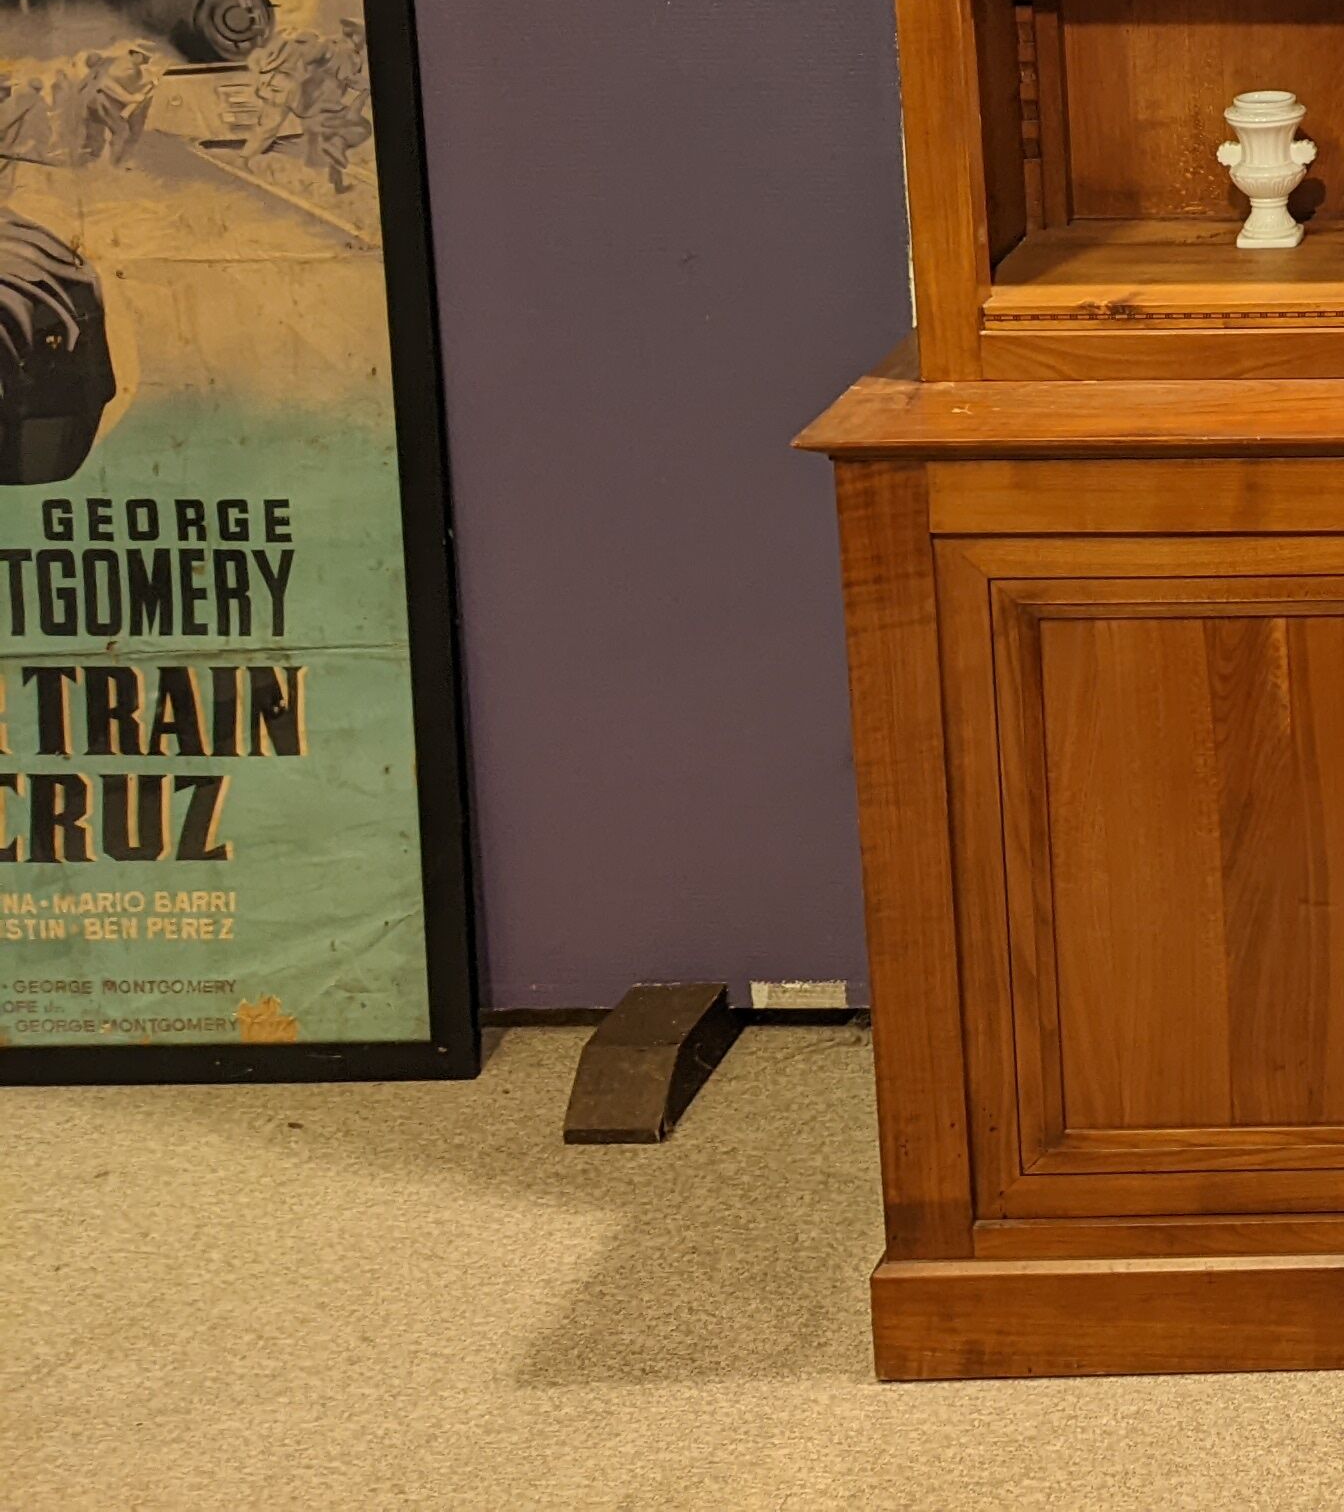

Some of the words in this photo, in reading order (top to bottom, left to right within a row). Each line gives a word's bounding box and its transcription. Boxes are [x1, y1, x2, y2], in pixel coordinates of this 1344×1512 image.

[42, 498, 292, 543] GEORGE
[0, 548, 295, 637] TGOMERY
[22, 666, 308, 757] TRAIN
[54, 891, 146, 915] MARIO
[154, 890, 237, 914] BARRI
[0, 918, 66, 940] STIN
[84, 917, 138, 940] BEN
[147, 917, 235, 940] PEREZ
[13, 979, 93, 995] GEORGE
[101, 978, 237, 995] MONTGOMERY
[15, 1019, 96, 1033] GEORGE
[100, 1018, 239, 1034] MONTGOMERY
